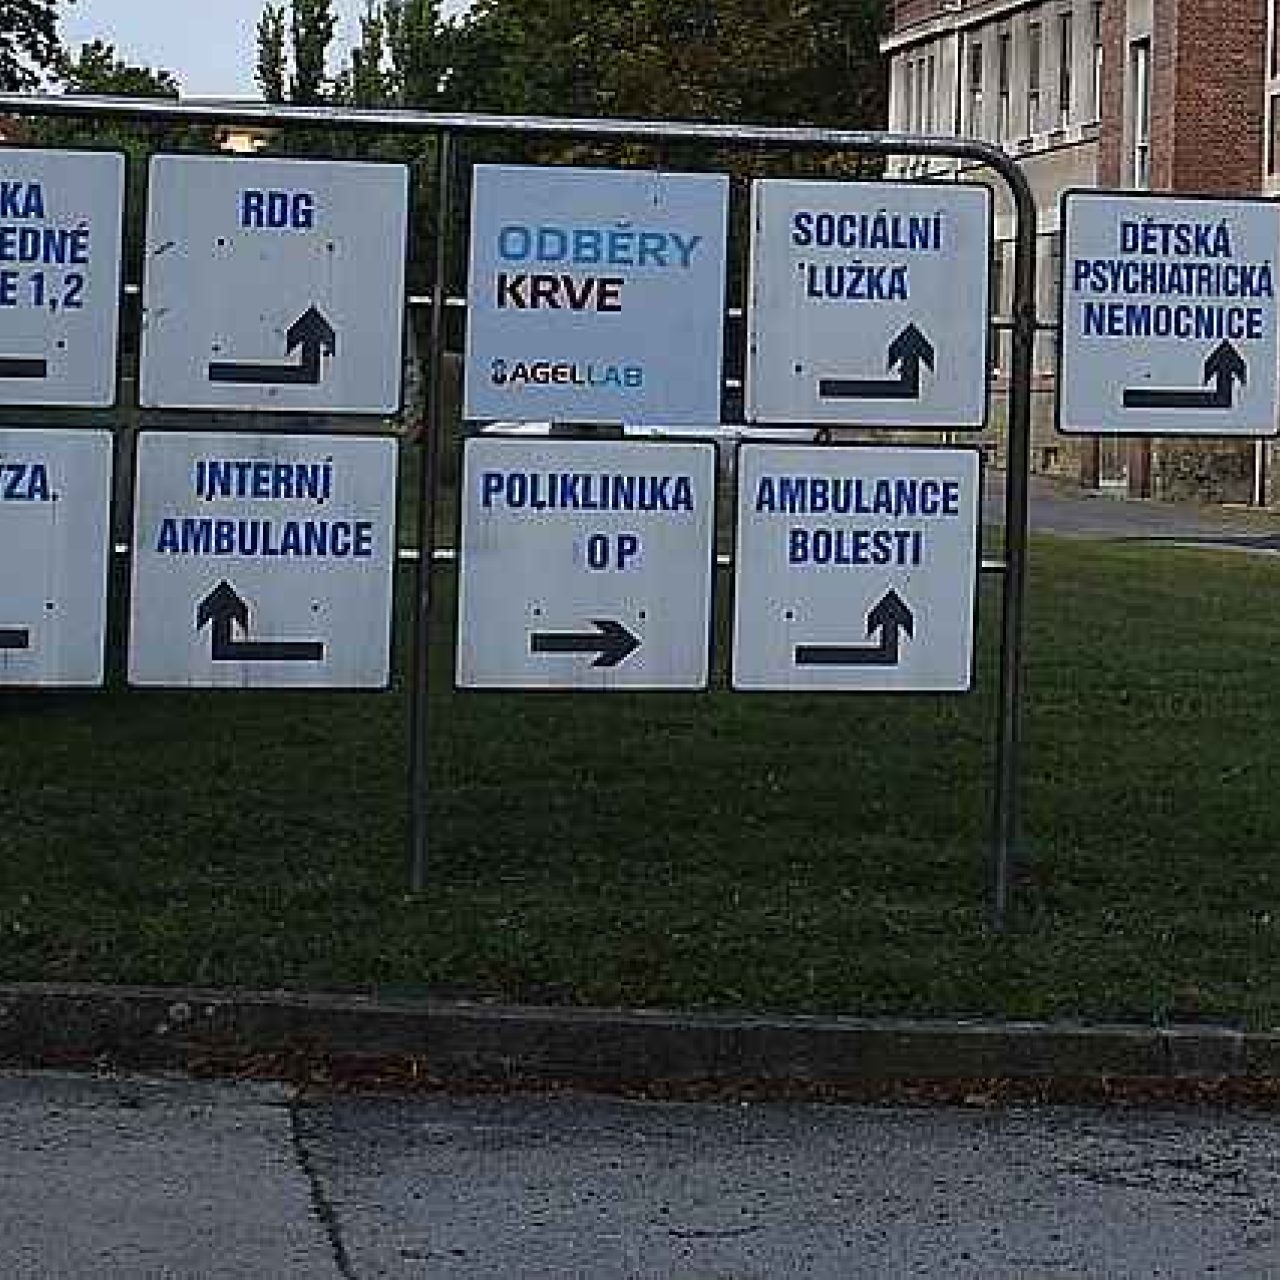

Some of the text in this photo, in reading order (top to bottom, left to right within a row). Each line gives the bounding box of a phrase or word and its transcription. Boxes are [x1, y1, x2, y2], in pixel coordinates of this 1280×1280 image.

[241, 191, 313, 229] RDG
[791, 208, 945, 250] SOCIÁLNÍ
[498, 221, 703, 267] ODBĚRY
[1120, 217, 1232, 258] DĚTSKÁ
[497, 274, 625, 312] KRVE
[1074, 259, 1273, 297] PSYCHIATRICKÁ
[1083, 301, 1263, 339] NEMOCNICE
[0, 464, 50, 501] ZA
[195, 456, 333, 499] INTERNÍ
[482, 473, 694, 511] POLIKLINIKA
[756, 476, 959, 516] AMBULANCE
[155, 518, 372, 556] AMBULANCE
[788, 529, 922, 565] BOLESTI
